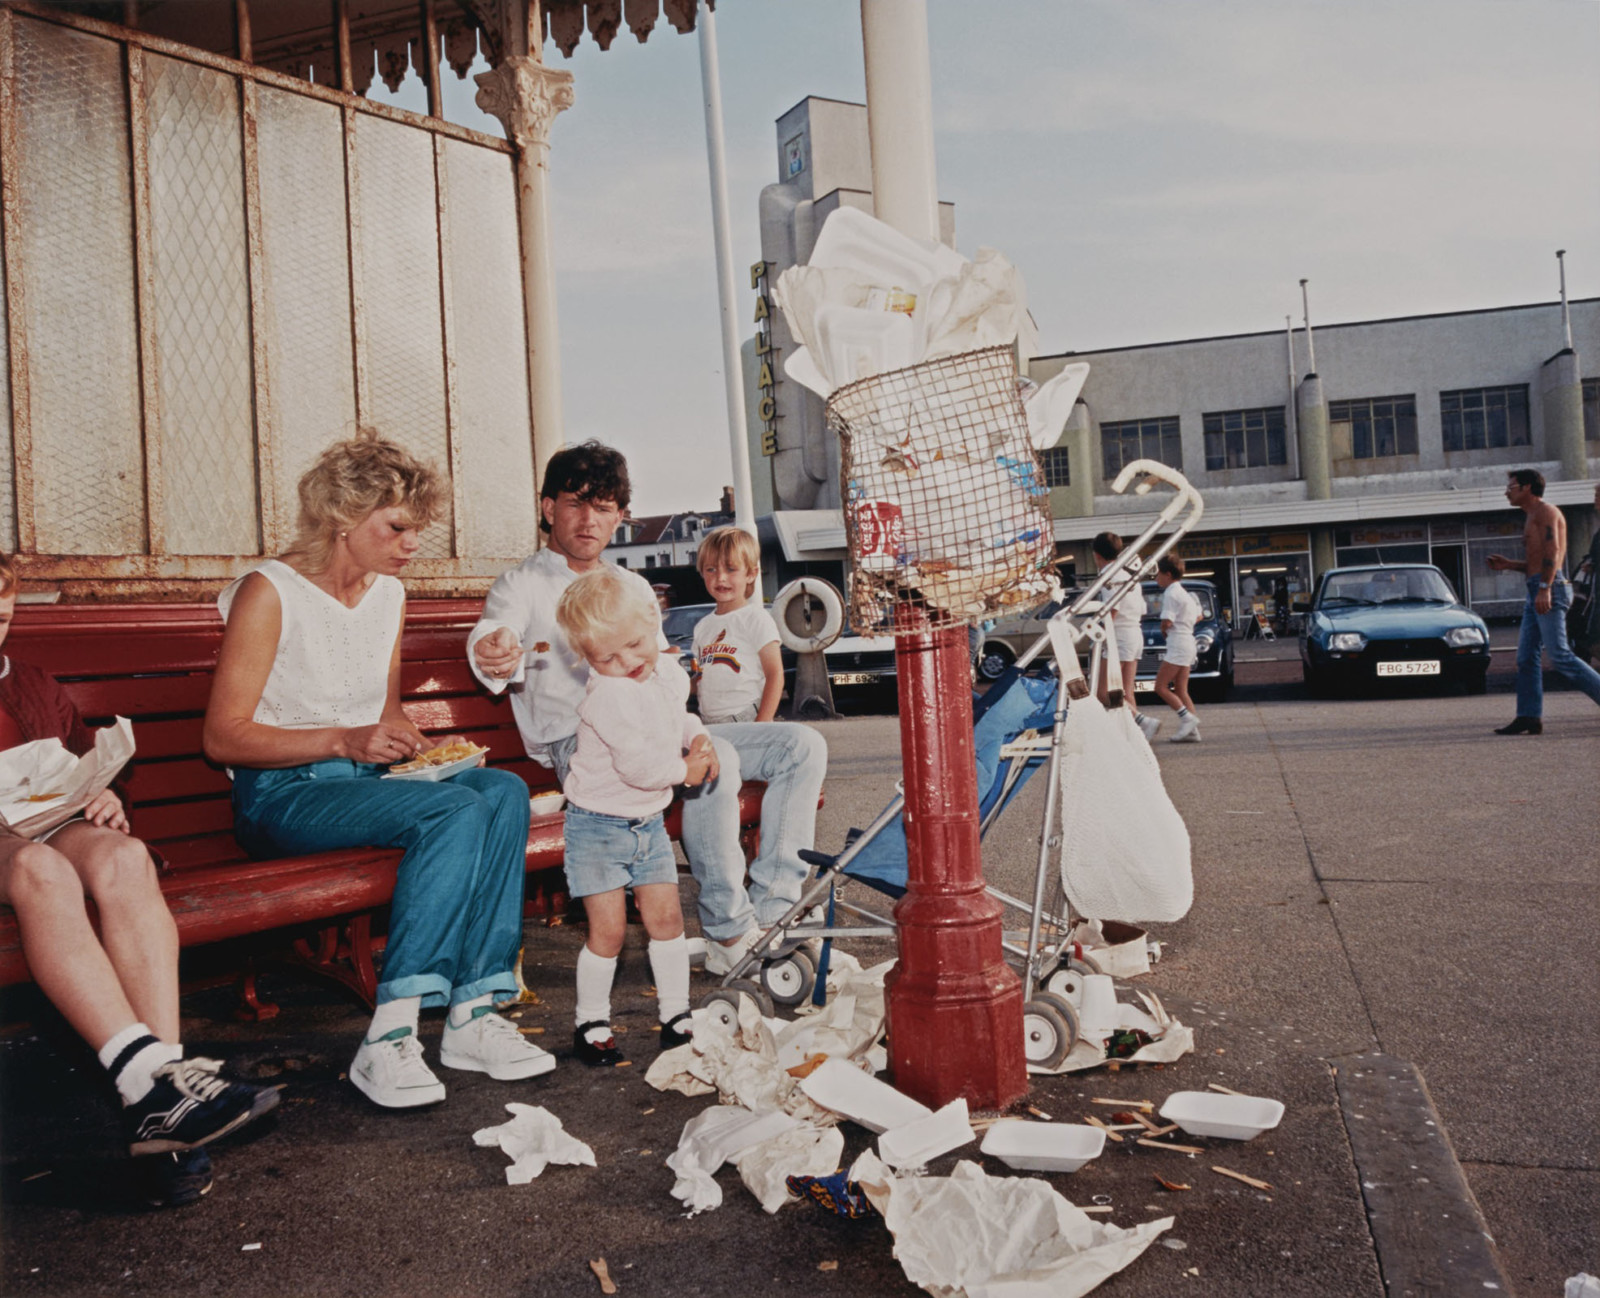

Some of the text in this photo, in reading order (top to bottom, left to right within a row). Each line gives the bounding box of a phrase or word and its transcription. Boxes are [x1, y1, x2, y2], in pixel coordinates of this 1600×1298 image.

[750, 260, 778, 457] PALACE
[1354, 529, 1423, 543] DONUTS
[702, 645, 738, 657] SAILING
[1378, 662, 1438, 674] FBG 572Y
[834, 674, 852, 684] PHF
